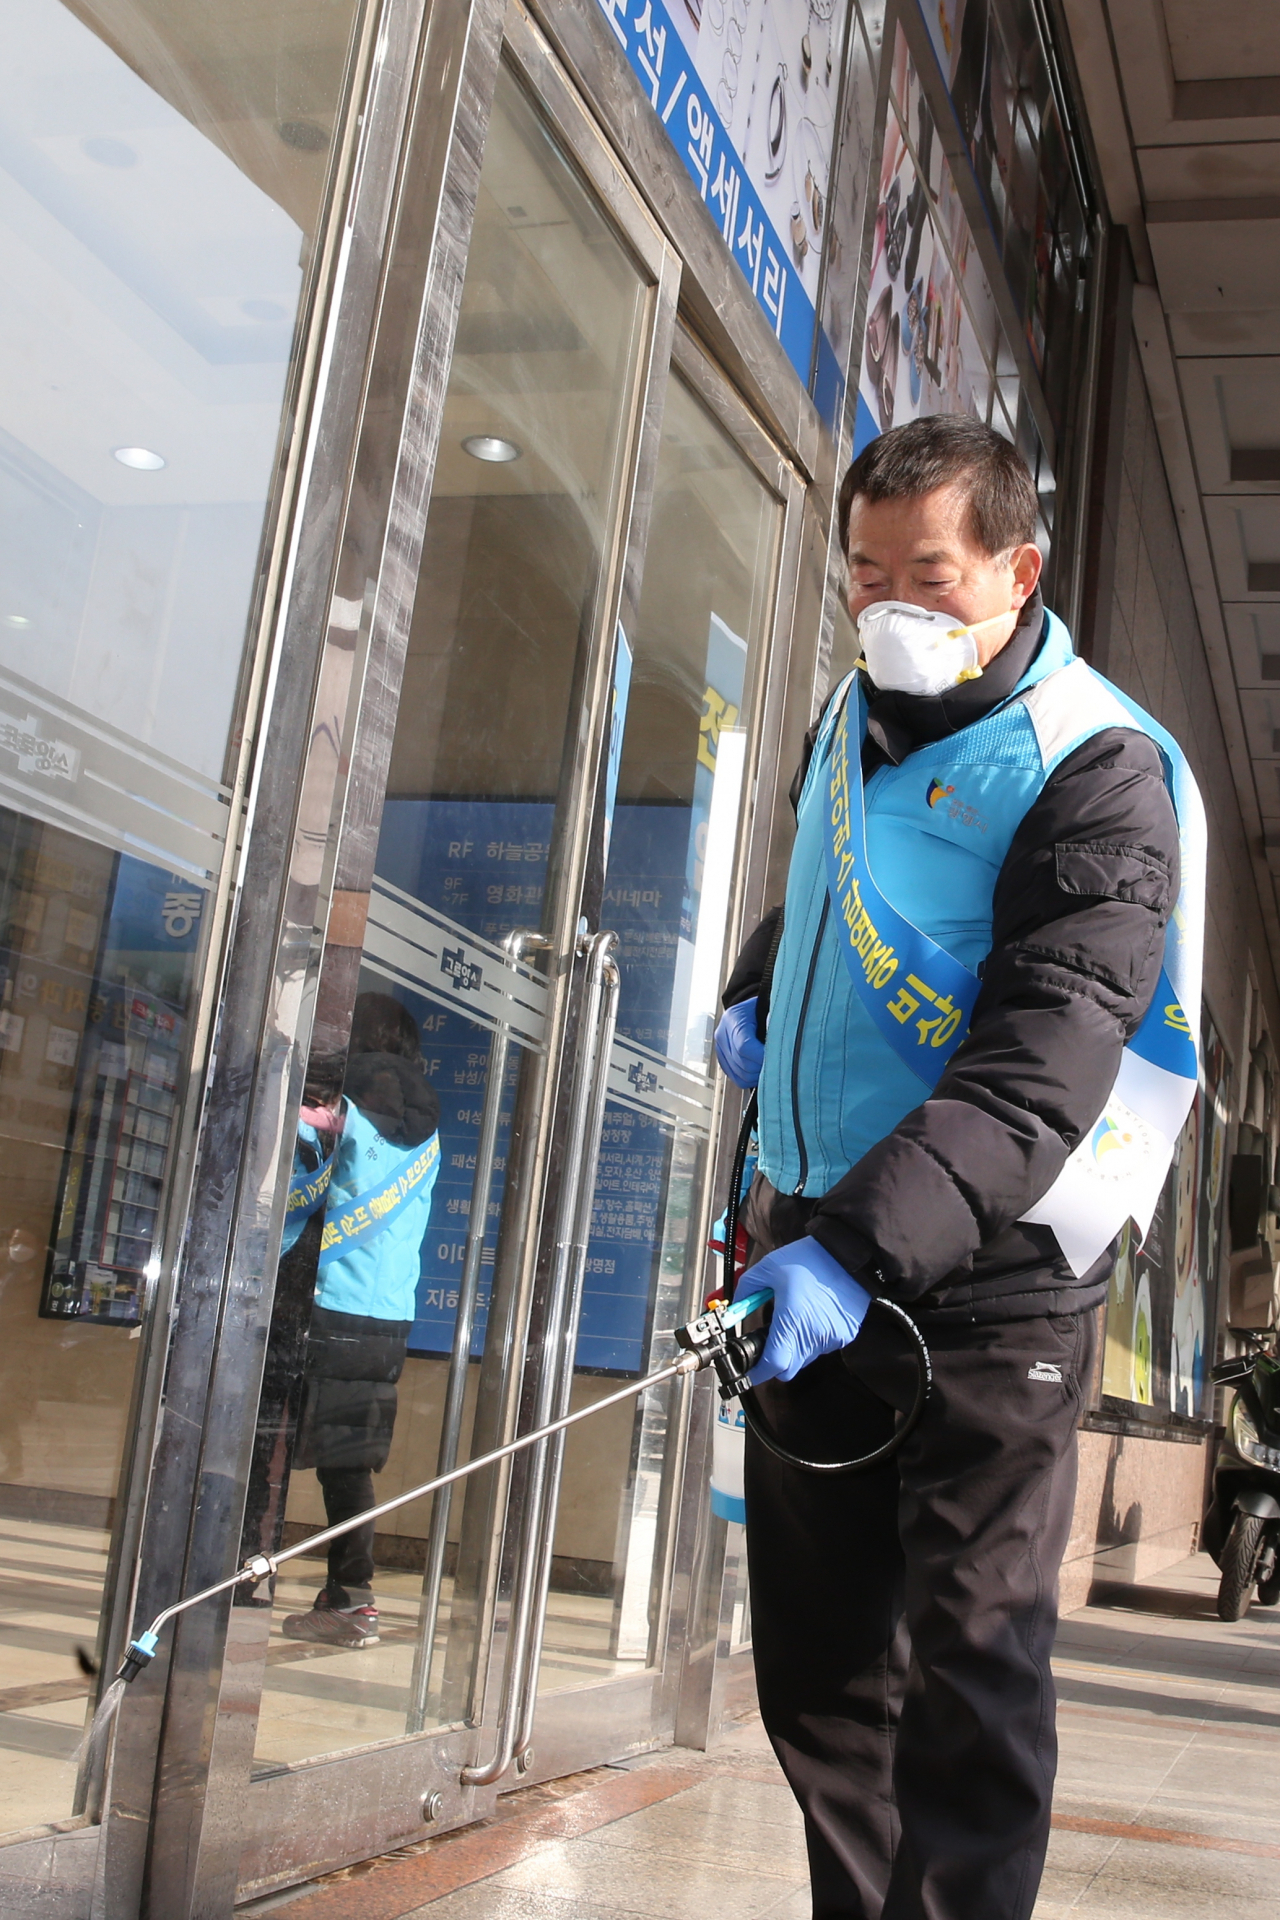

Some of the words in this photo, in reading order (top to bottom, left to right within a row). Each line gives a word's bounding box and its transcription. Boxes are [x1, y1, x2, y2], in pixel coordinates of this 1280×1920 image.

[448, 842, 474, 858] RF
[444, 877, 462, 890] 9F
[487, 885, 543, 905] 영화관
[842, 877, 900, 990] 감염증
[886, 973, 963, 1048] 비상
[423, 1015, 447, 1031] 4F
[457, 1109, 512, 1127] 여성류
[451, 1153, 506, 1172] 패션화
[446, 1198, 502, 1217] 생활화
